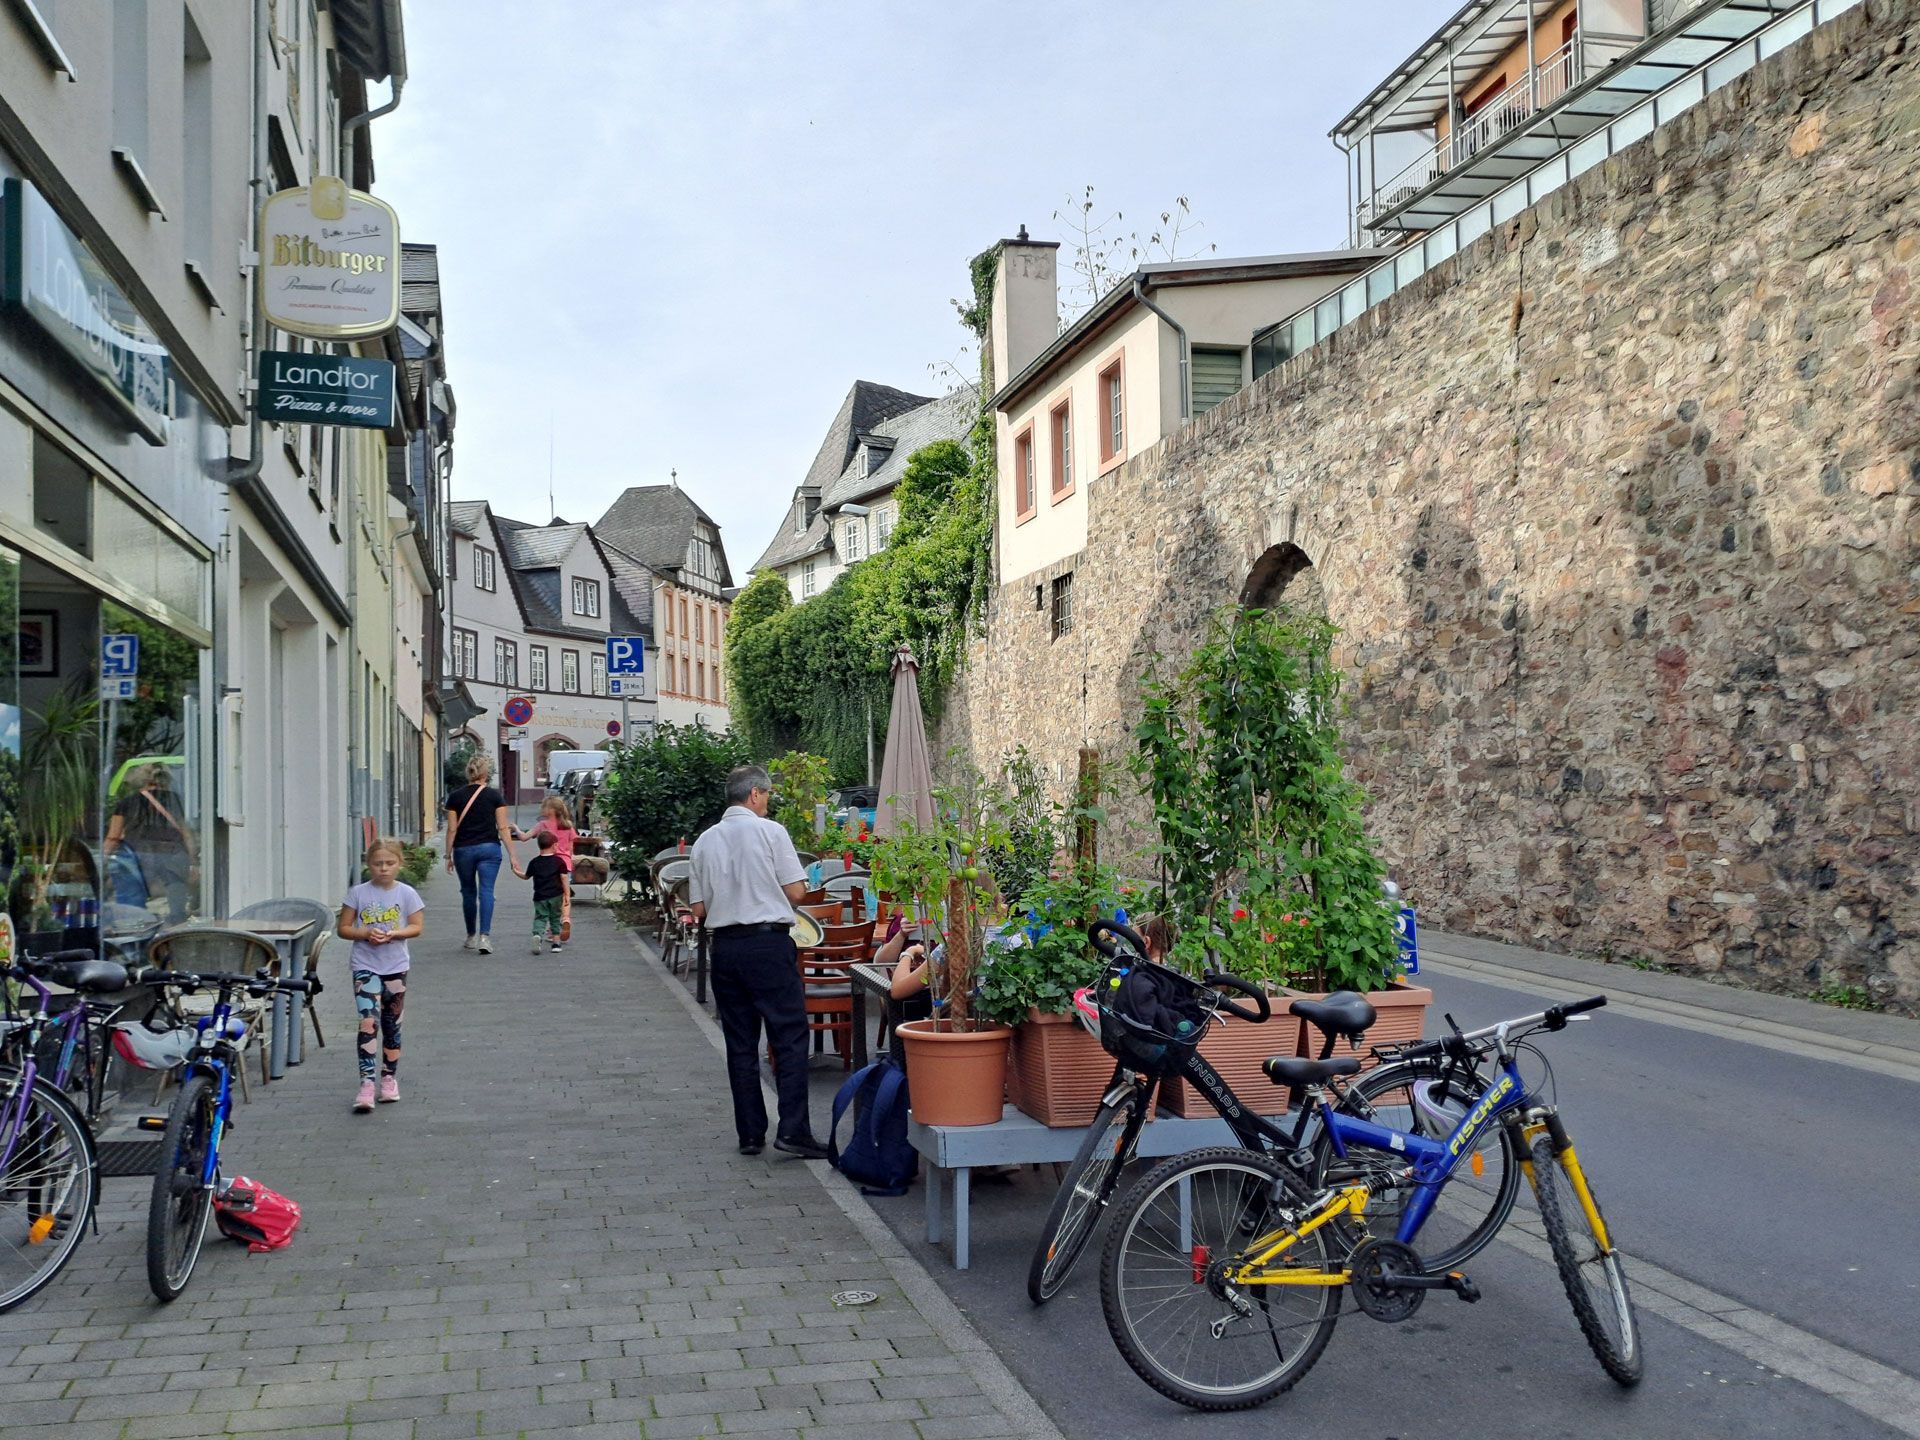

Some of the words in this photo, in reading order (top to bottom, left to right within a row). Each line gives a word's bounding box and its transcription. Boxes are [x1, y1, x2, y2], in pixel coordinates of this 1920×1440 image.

[270, 233, 386, 275] Bitburger
[275, 361, 379, 390] Landtor
[274, 394, 322, 411] Pizza
[325, 401, 337, 413] &
[340, 403, 378, 416] more
[612, 641, 633, 669] P
[1450, 1077, 1514, 1156] FISCHER
